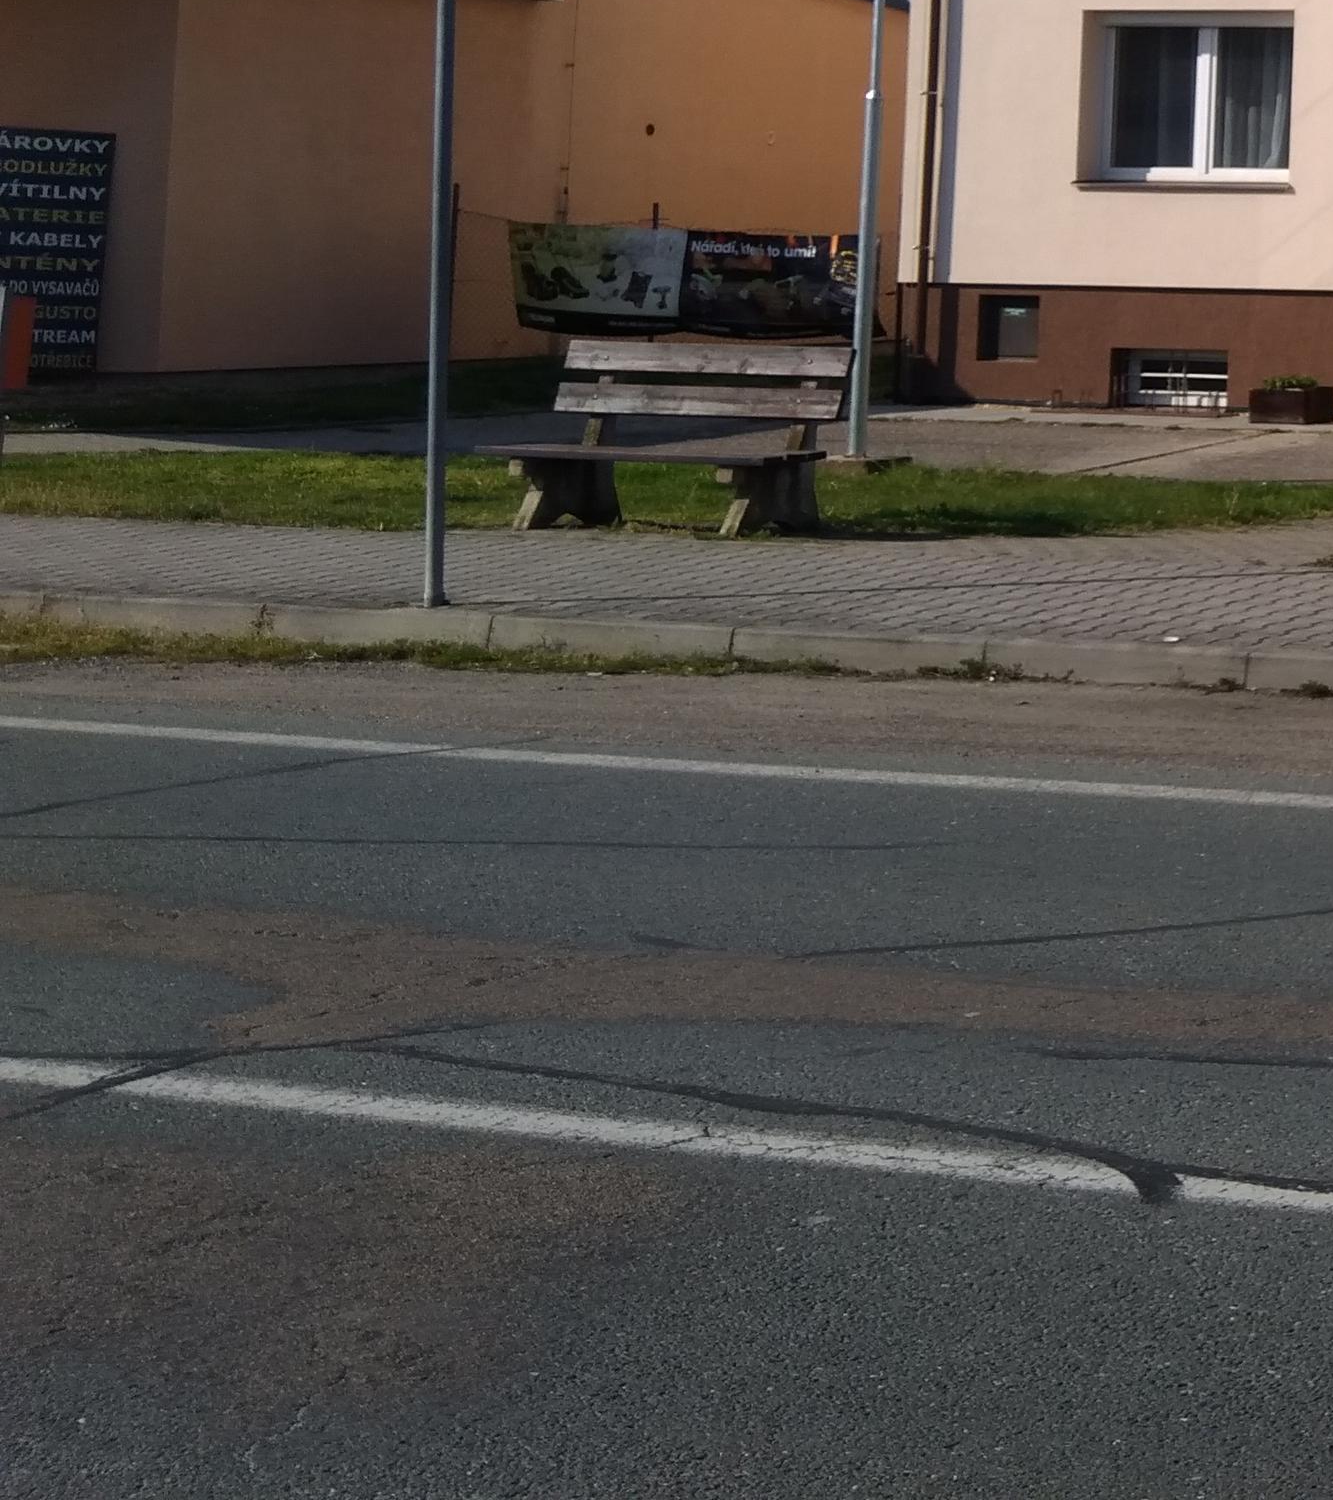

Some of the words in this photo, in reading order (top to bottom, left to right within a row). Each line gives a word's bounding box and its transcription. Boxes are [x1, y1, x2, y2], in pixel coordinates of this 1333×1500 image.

[0, 130, 111, 153] ÁROVKY
[0, 158, 108, 177] ODLUŽKY
[9, 231, 103, 249] KABELY
[690, 239, 738, 255] Nářadí,
[767, 244, 781, 257] to
[784, 244, 818, 258] umí!
[32, 278, 101, 297] VYSAVAČŮ
